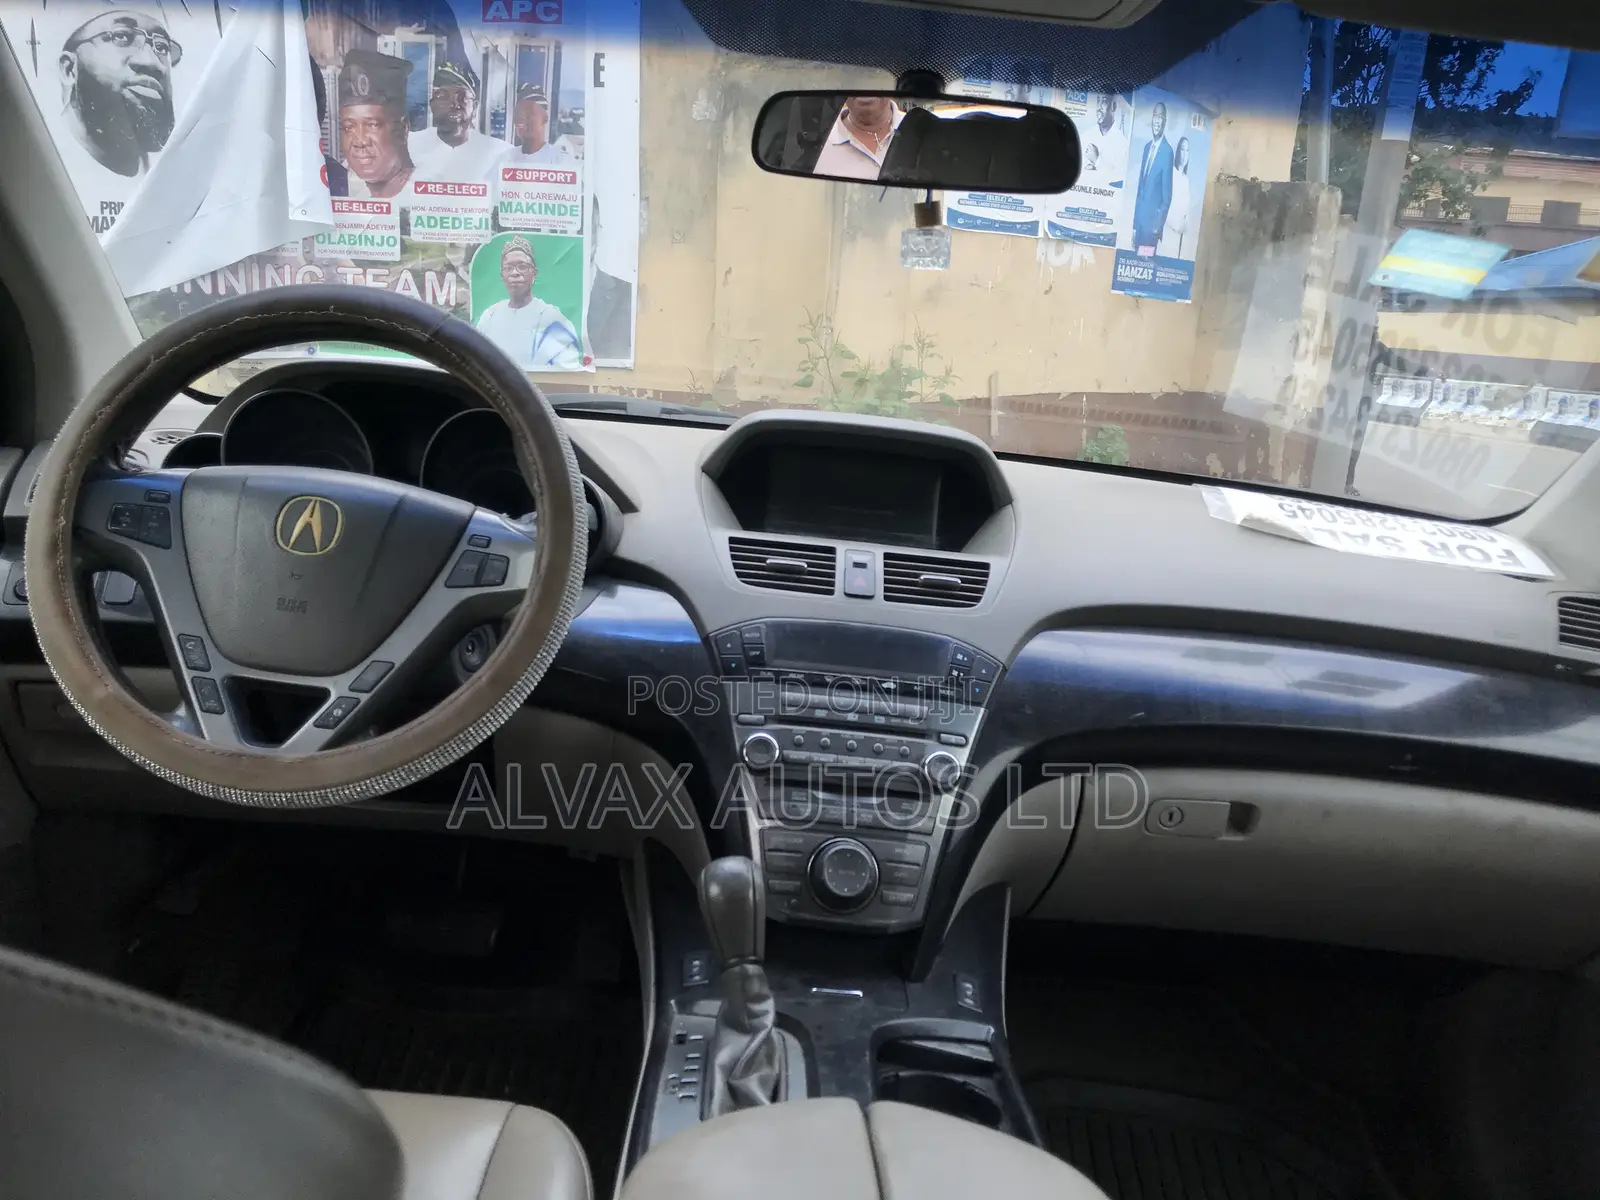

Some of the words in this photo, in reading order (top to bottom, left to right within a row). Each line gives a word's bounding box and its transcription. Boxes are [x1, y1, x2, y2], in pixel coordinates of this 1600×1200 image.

[485, 0, 560, 22] APC
[515, 170, 573, 182] SUPPORT
[427, 183, 485, 195] RE-ELECT
[524, 191, 578, 202] OLAREWAJU
[1092, 187, 1115, 197] SUNDAY
[334, 201, 389, 213] RE-ELECT
[500, 201, 580, 217] MAKINDE
[413, 215, 490, 230] ADEDEJI
[315, 232, 398, 248] OLABINJO
[1117, 263, 1154, 280] HAMZAT
[337, 266, 457, 306] TEAM
[1312, 526, 1408, 552] SAL
[1419, 538, 1526, 568] FOR
